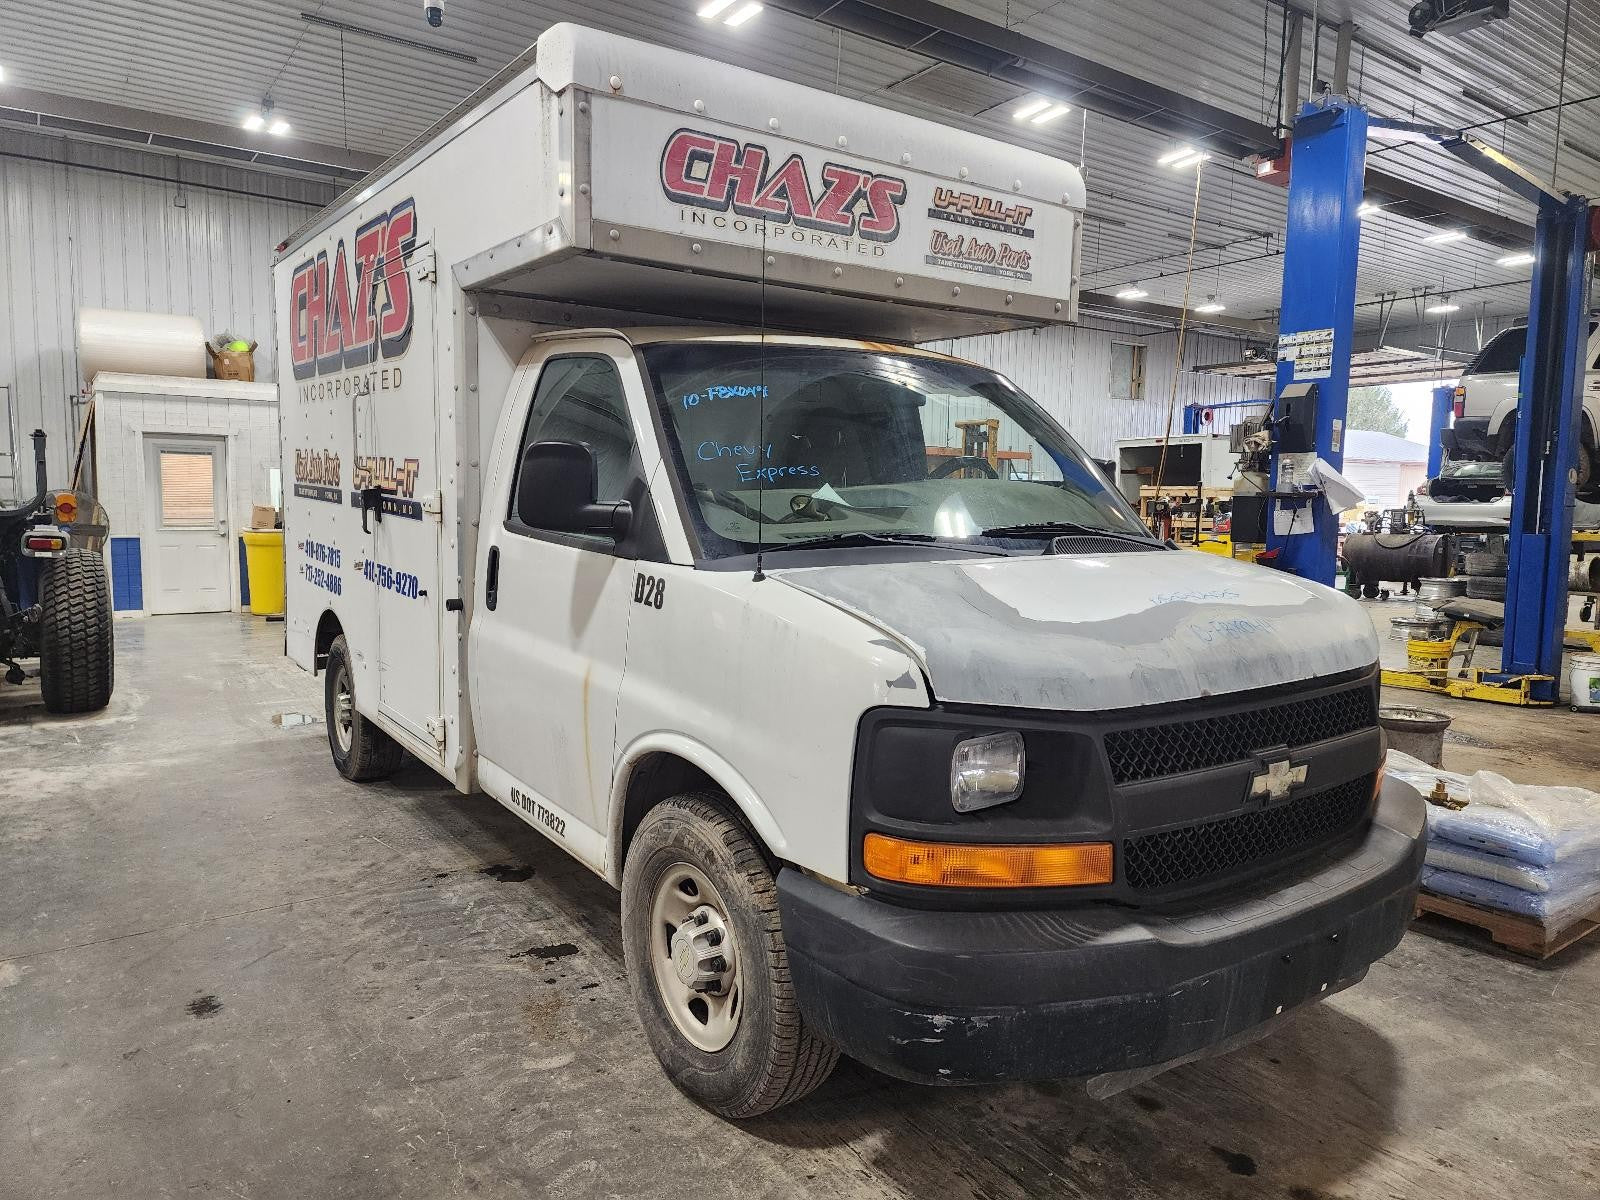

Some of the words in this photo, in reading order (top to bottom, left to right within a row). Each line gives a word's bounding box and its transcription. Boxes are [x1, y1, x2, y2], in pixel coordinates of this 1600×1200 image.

[660, 128, 907, 243] CHAZ'S
[934, 187, 1033, 226] U-PULL-IT
[680, 209, 886, 258] INCORPORATED
[930, 230, 964, 258] Used
[963, 237, 996, 263] Auto
[996, 242, 1031, 270] Parts
[290, 197, 417, 380] CHAZ'S
[299, 368, 402, 404] INCORPORATED
[736, 463, 820, 483] Express
[634, 573, 665, 609] D28
[511, 787, 520, 806] US
[522, 794, 536, 816] DOT
[537, 804, 565, 837] 773822
